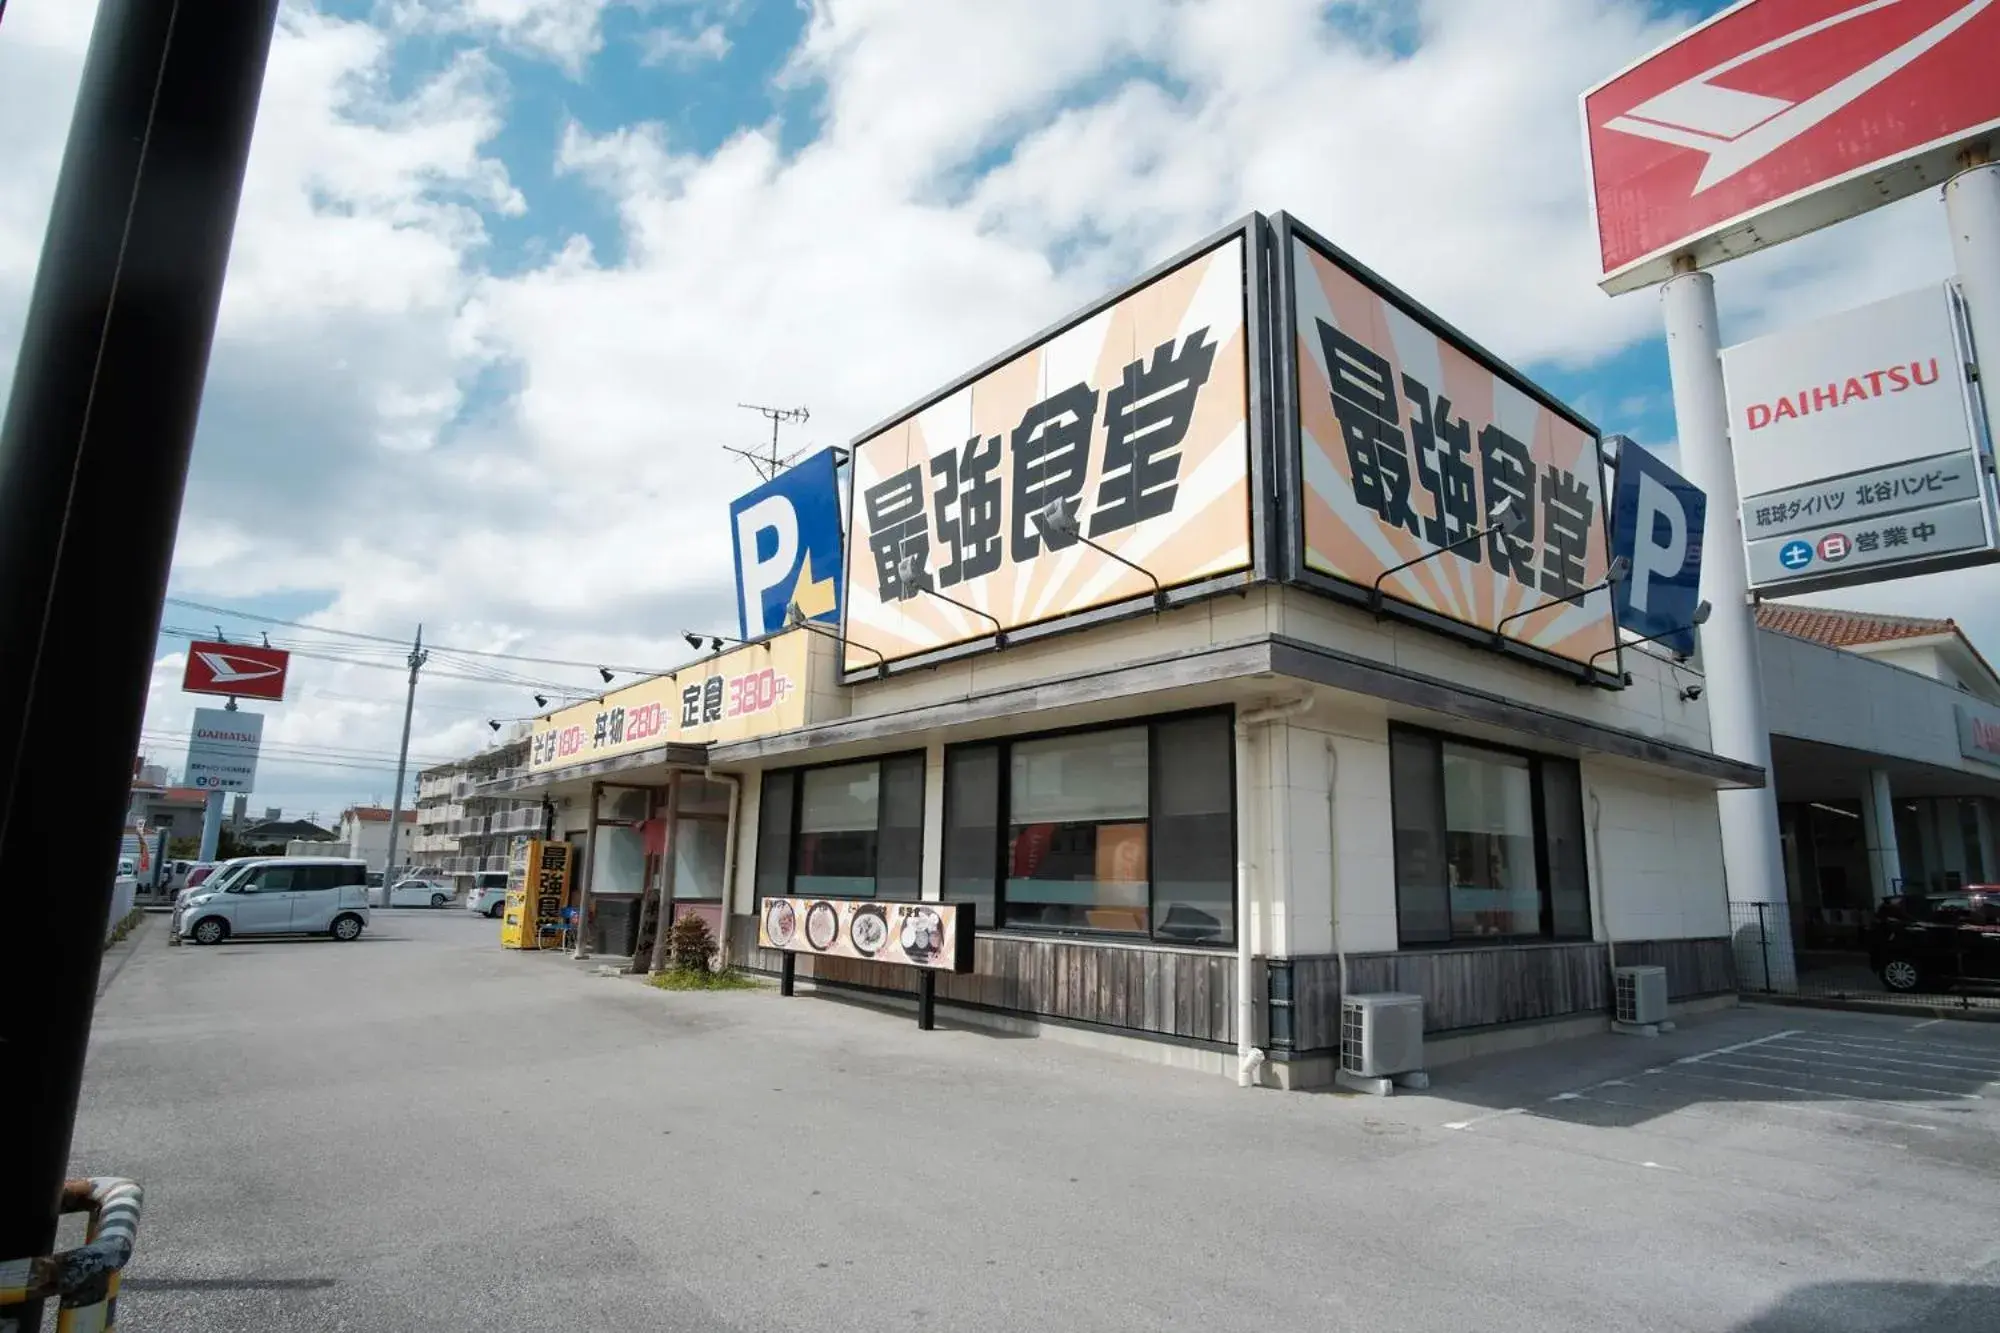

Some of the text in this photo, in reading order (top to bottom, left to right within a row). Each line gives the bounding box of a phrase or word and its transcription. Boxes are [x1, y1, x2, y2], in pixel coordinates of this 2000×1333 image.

[864, 325, 1218, 605] 最強食堂
[1315, 317, 1594, 608] 最強食堂
[1746, 357, 1940, 431] DAIHATSU
[737, 493, 801, 641] P
[1629, 470, 1688, 613] P
[1755, 471, 1960, 527] 琉球ダイハツ 北谷ハンビー
